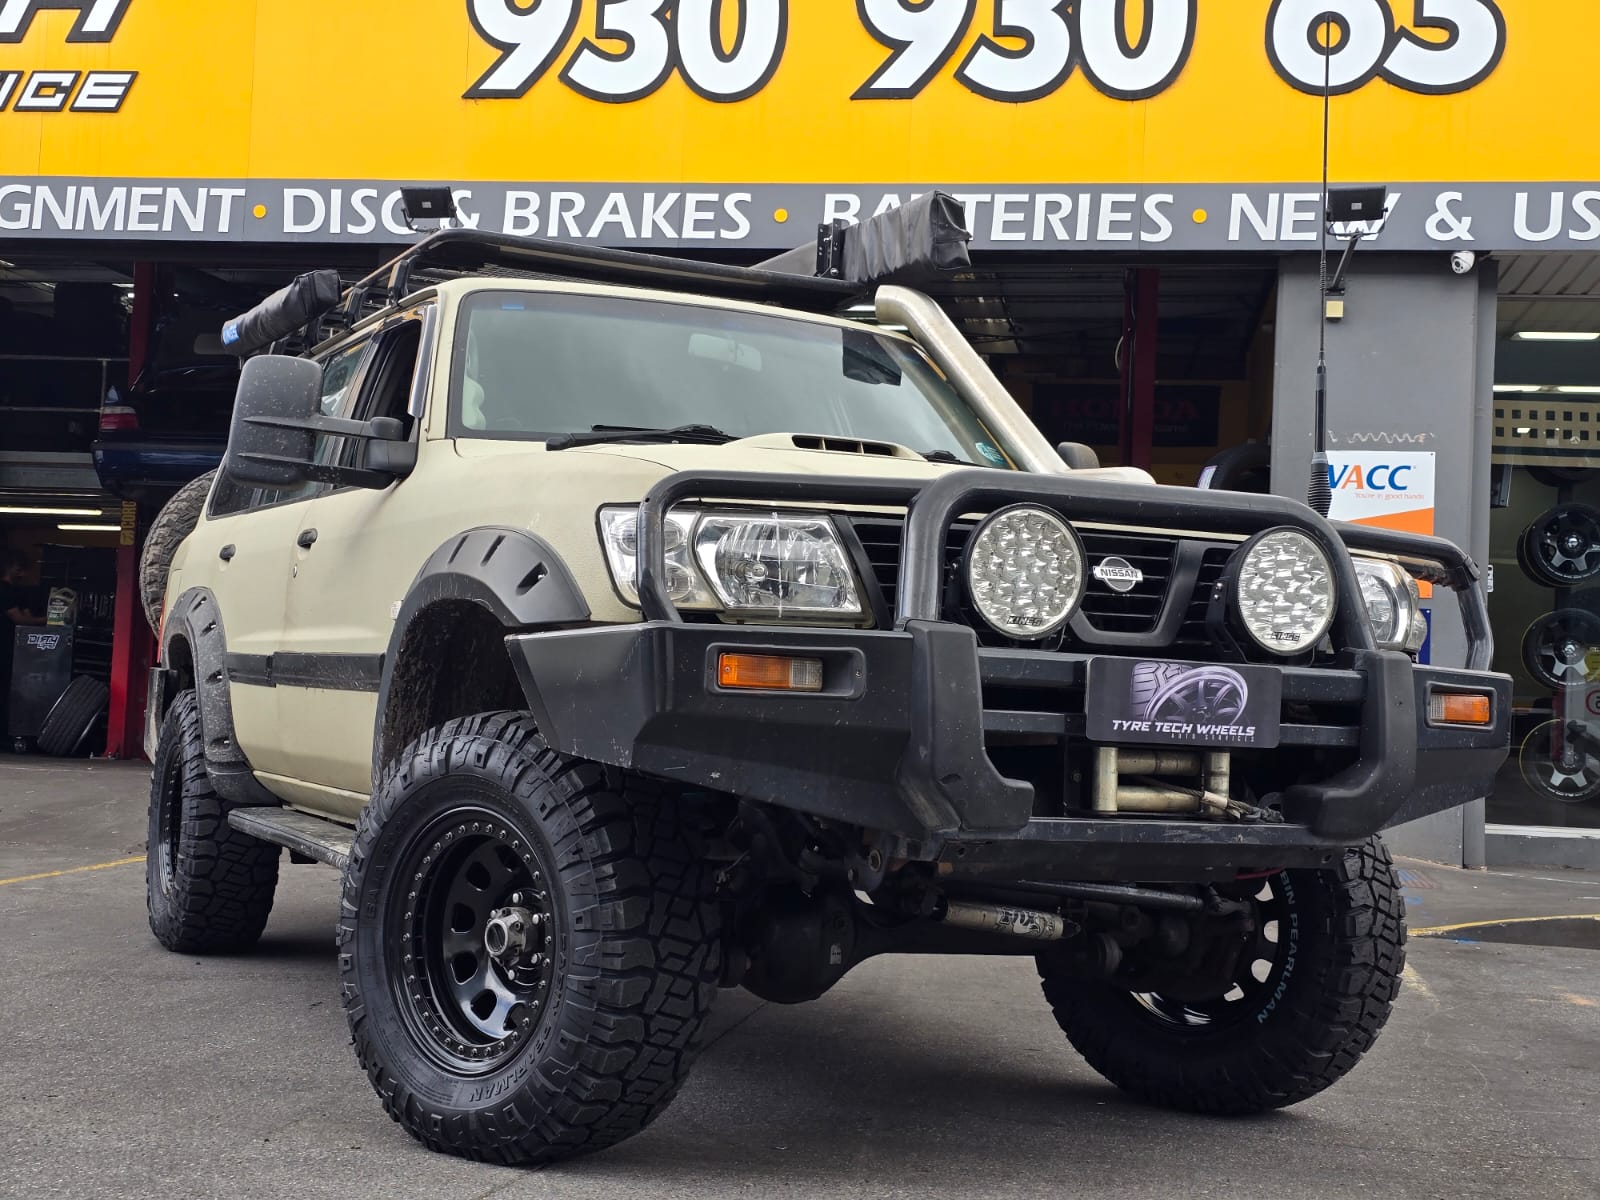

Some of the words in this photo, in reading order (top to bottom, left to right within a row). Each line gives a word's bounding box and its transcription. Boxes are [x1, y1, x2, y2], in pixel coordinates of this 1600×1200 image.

[0, 184, 246, 233] GNMENT
[501, 190, 752, 240] BRAKES
[823, 193, 1174, 242] BTERIES
[1425, 191, 1475, 241] &
[1513, 190, 1600, 242] US
[1100, 568, 1138, 579] NISSAN
[1112, 719, 1152, 732] TYRE
[1154, 721, 1193, 734] TECH
[1196, 723, 1256, 737] WHEELS
[1256, 913, 1299, 1025] PEARLMAN
